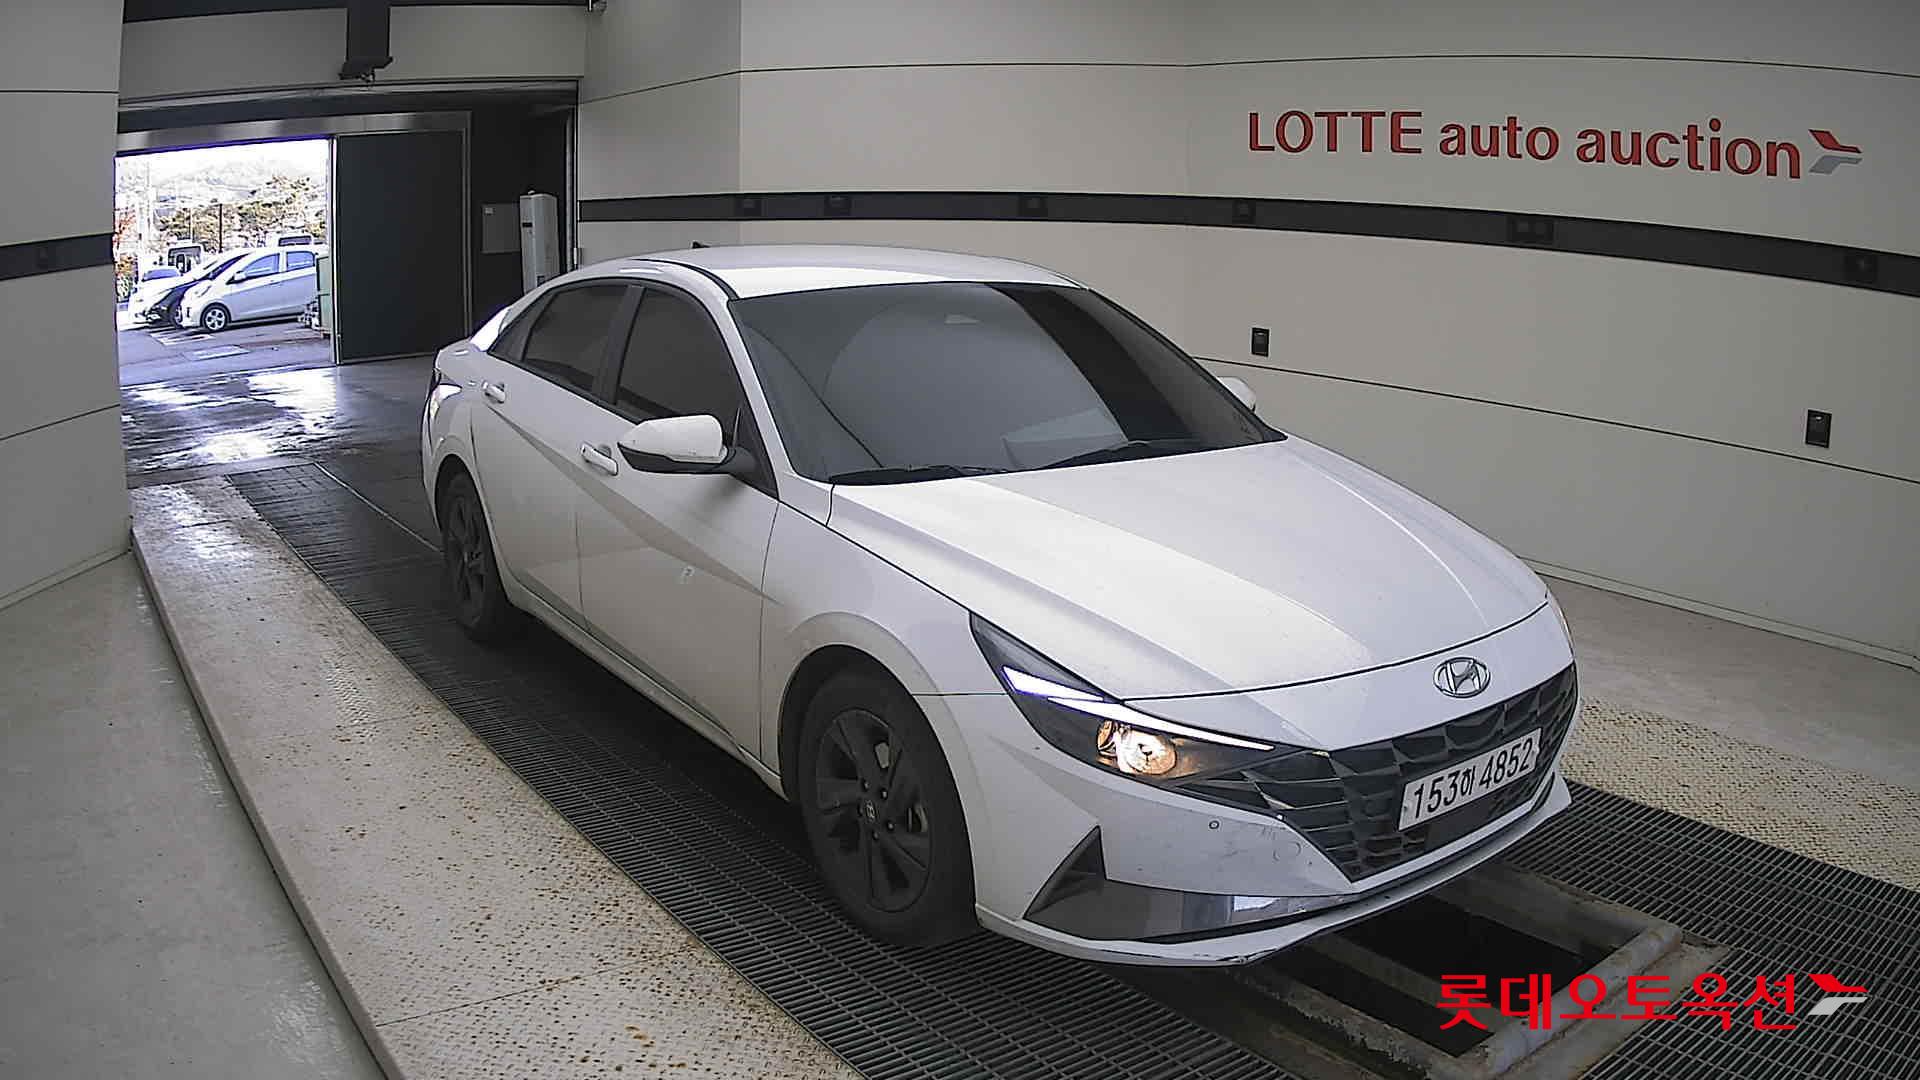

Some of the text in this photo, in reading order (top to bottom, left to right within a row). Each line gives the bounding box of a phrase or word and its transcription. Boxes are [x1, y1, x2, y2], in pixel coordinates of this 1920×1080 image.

[1249, 111, 1800, 178] LOTTE auto auction
[1479, 738, 1533, 789] 4852
